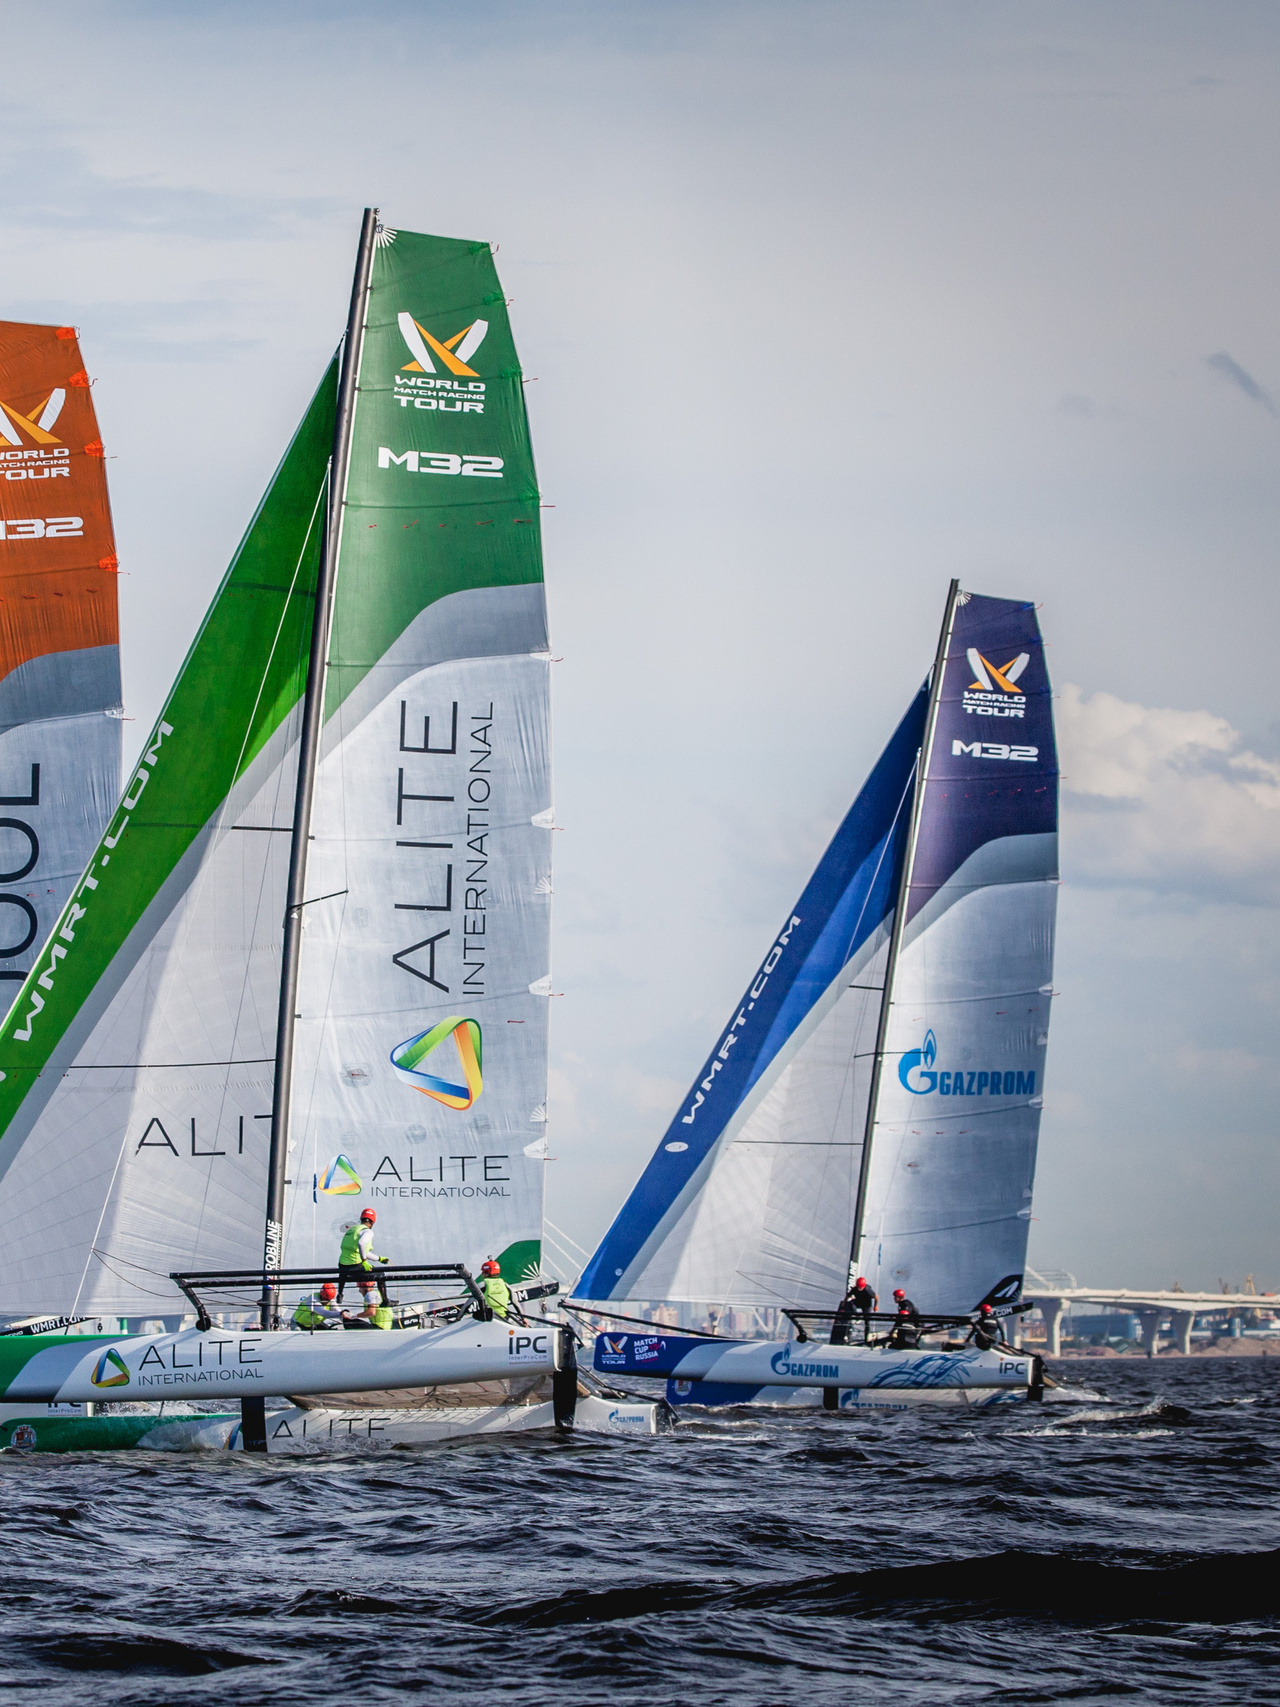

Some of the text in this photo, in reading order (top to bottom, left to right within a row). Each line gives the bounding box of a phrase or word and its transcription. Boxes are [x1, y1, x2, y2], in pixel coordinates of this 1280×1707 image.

[394, 374, 486, 392] WORLD
[393, 386, 486, 400] MATCH RACING
[393, 395, 485, 414] TOUR
[26, 458, 70, 467] RACING
[377, 446, 505, 478] M32
[963, 691, 1026, 703] WORLD
[962, 705, 1025, 718] TOUR
[951, 739, 1039, 762] M32
[392, 700, 458, 994] ALITE
[462, 701, 494, 995] INTERNATIONAL
[13, 720, 174, 1041] WMRT.COM
[681, 915, 801, 1124] WMRT.COM
[939, 1070, 1036, 1096] GAZPROM
[134, 1114, 273, 1157] ALI
[371, 1155, 511, 1182] ALITE
[371, 1185, 511, 1198] INTERNATIONAL
[633, 1337, 658, 1347] MATCH
[634, 1346, 649, 1354] CUP
[138, 1338, 263, 1371] ALITE
[635, 1350, 659, 1361] RUSSIA
[138, 1368, 264, 1386] INTERNATIONAL
[790, 1363, 839, 1378] GAZPROM
